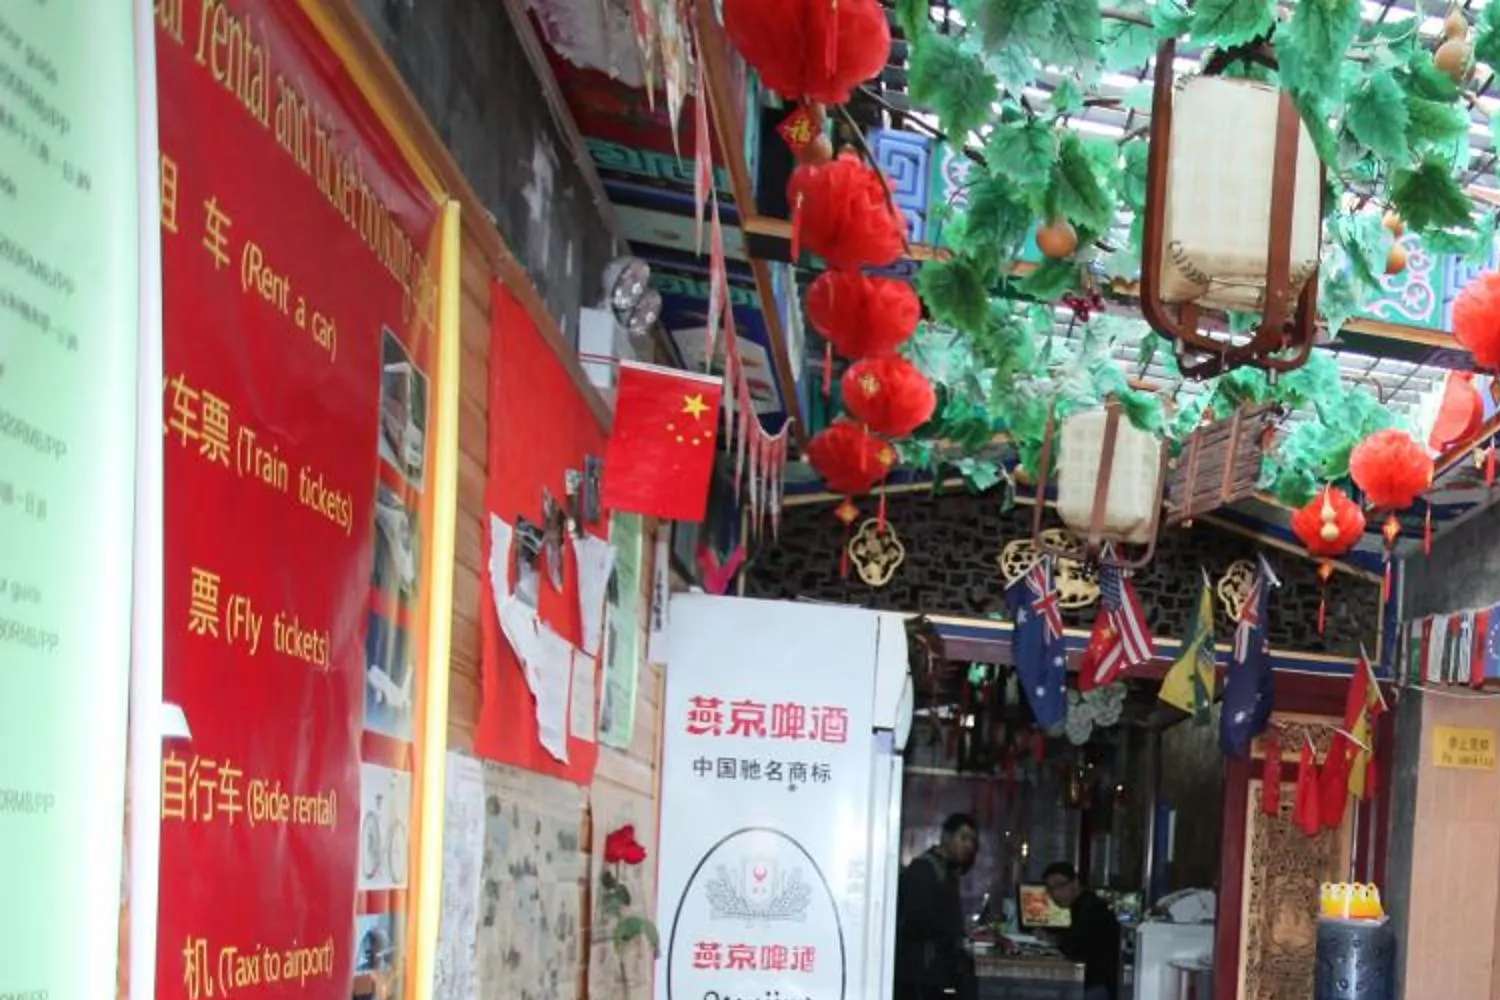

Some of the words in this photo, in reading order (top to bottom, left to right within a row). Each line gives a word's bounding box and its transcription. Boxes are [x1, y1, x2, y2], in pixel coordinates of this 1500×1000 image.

[242, 240, 290, 315] (Rent
[295, 297, 305, 330] a
[311, 310, 337, 360] car)
[163, 373, 230, 468] 车票
[237, 424, 289, 493] (Train
[299, 464, 353, 537] tickets)
[188, 567, 220, 638] 票
[226, 594, 263, 656] (Fly
[273, 611, 331, 672] tickets)
[685, 695, 850, 744] 燕京啤酒
[161, 751, 243, 825] 自行车
[692, 756, 832, 785] 中国驰名商标
[218, 942, 262, 999] (Taxi
[263, 944, 281, 980] to
[283, 936, 334, 988] airport)
[691, 941, 816, 973] 燕京啤酒
